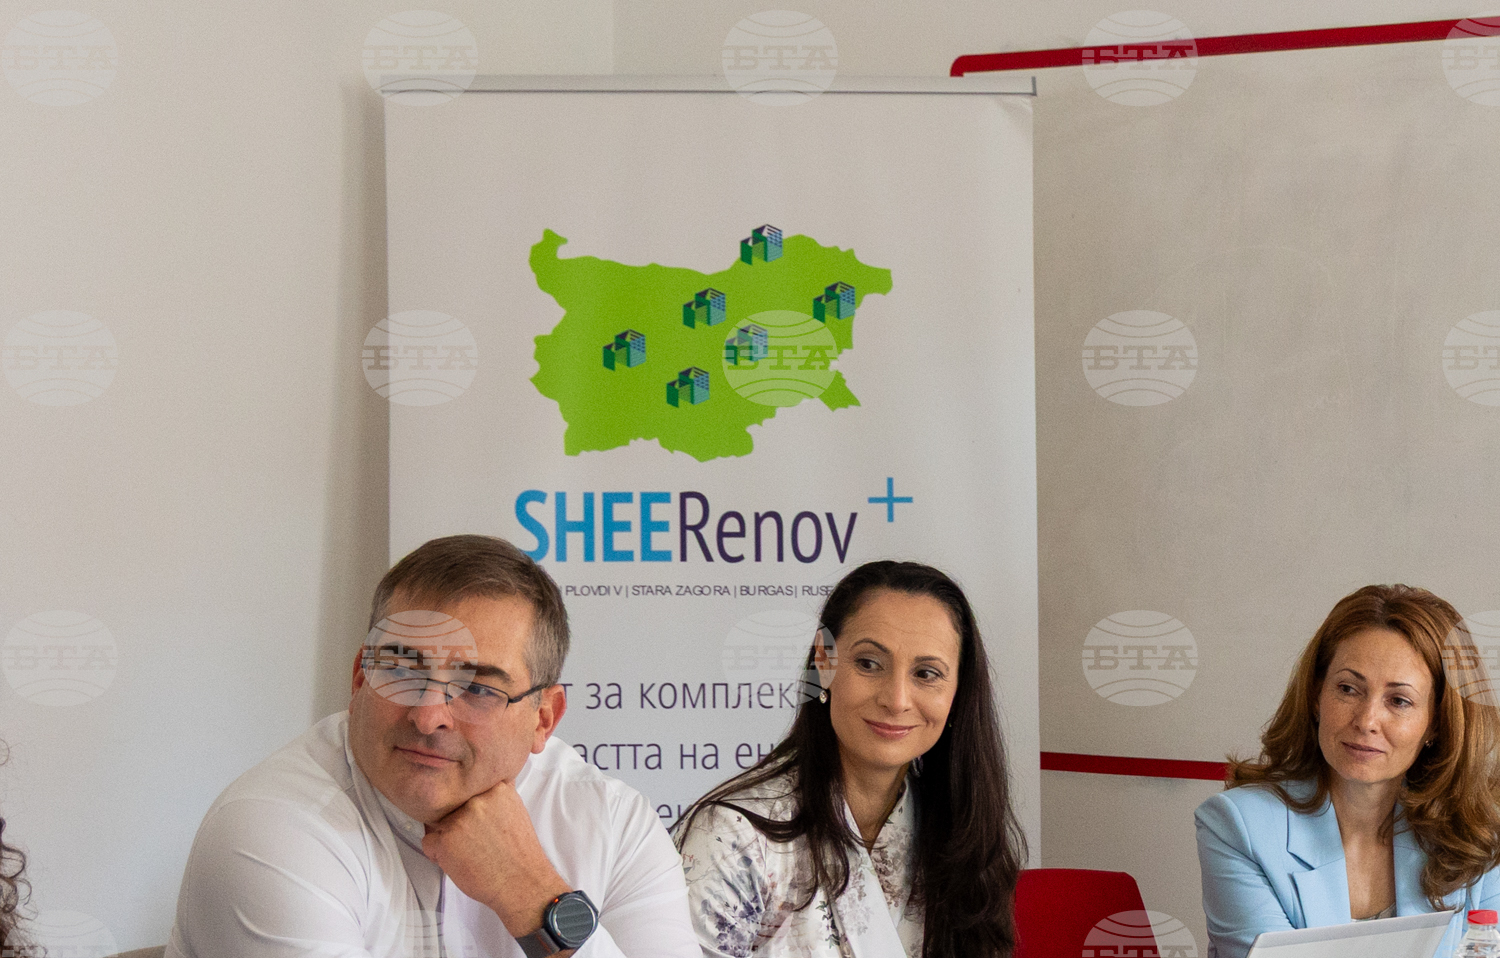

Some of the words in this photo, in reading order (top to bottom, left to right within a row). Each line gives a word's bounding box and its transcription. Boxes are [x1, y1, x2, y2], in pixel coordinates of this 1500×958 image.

[514, 489, 859, 564] SHEERenov
[631, 585, 673, 597] STARA
[675, 585, 731, 597] ZAGORA
[585, 682, 623, 710] за
[639, 682, 797, 710] комплек
[679, 742, 720, 771] на
